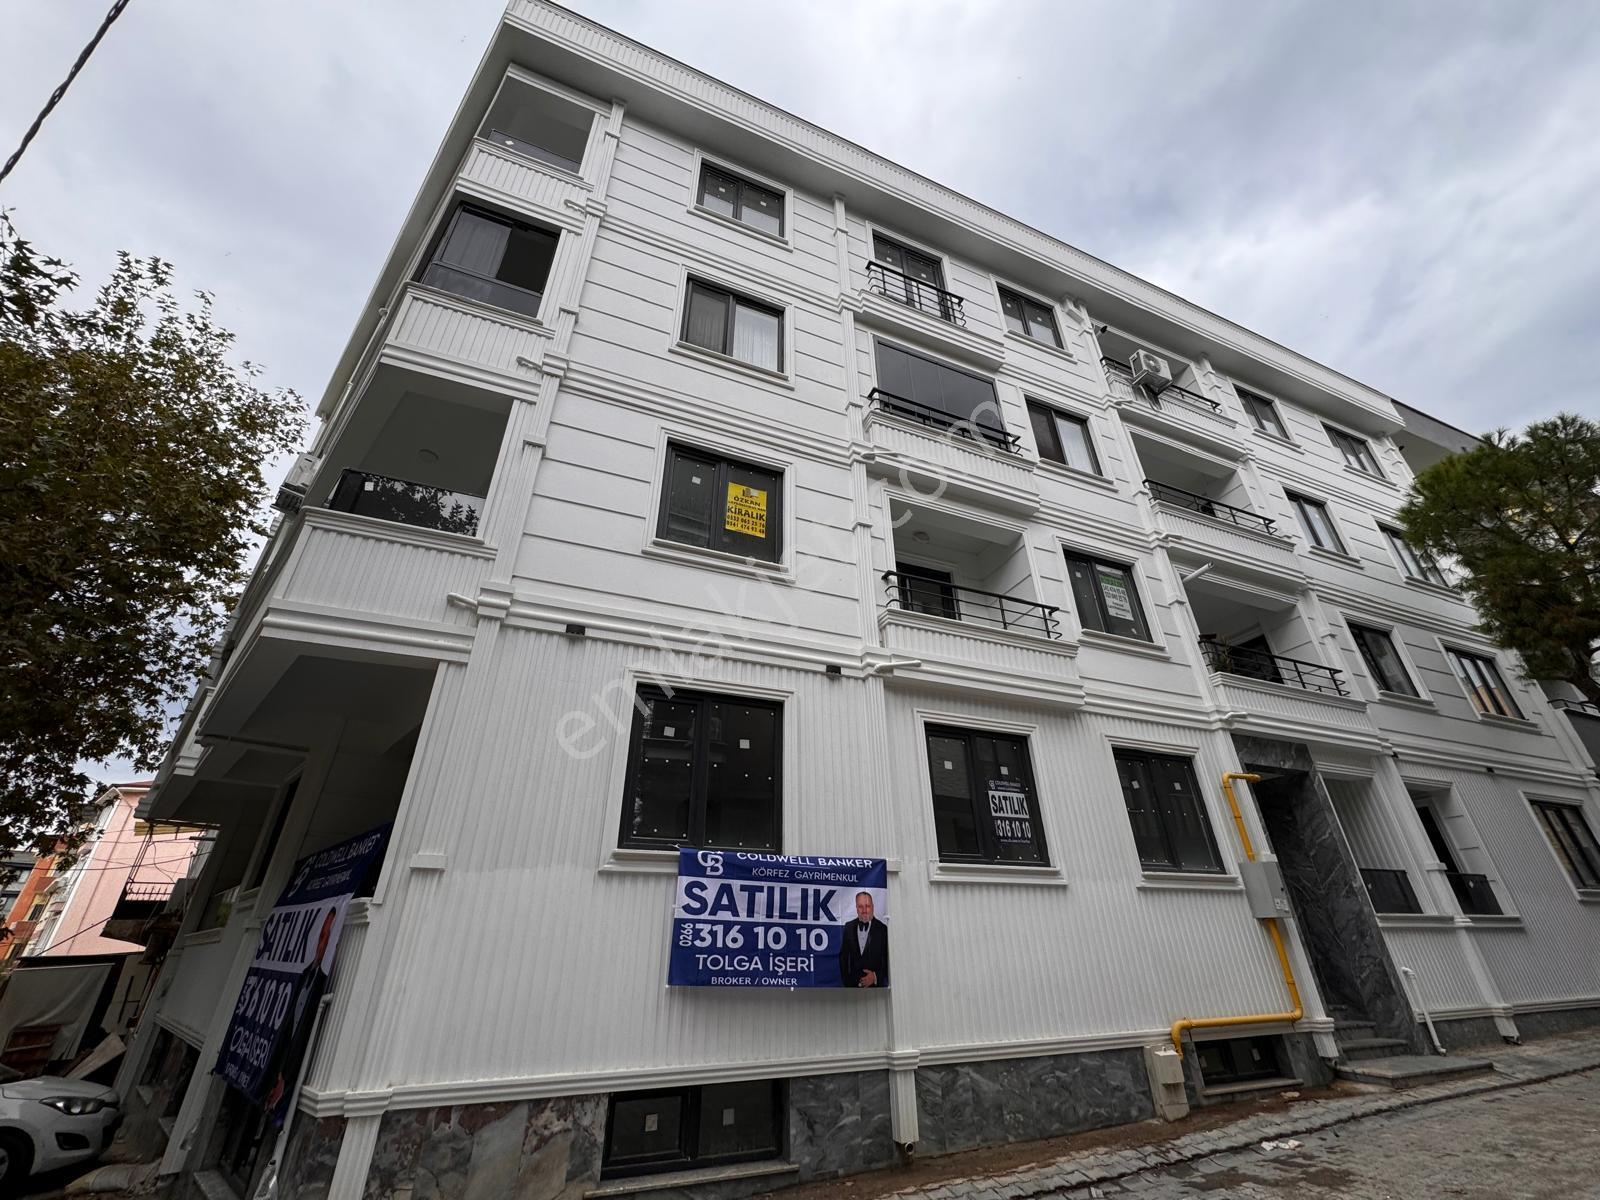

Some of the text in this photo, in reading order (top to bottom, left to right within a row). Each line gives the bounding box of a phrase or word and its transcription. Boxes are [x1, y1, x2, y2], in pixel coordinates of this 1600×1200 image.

[733, 495, 761, 507] ÖZKAN
[727, 505, 766, 522] KİRALIK
[990, 794, 1029, 816] SATILIK
[997, 819, 1032, 839] 316 10 10
[736, 852, 873, 869] COLDWELL BANKER
[752, 866, 859, 883] KÖRFEZ GAYRİMENKUL
[681, 880, 838, 922] SATILIK
[256, 907, 322, 964] SATILIK
[679, 923, 693, 947] 0266
[693, 923, 829, 951] 316 10 10
[695, 953, 814, 975] TOLGA İŞERİ
[711, 977, 751, 985] BROKER
[761, 977, 798, 986] OWNER
